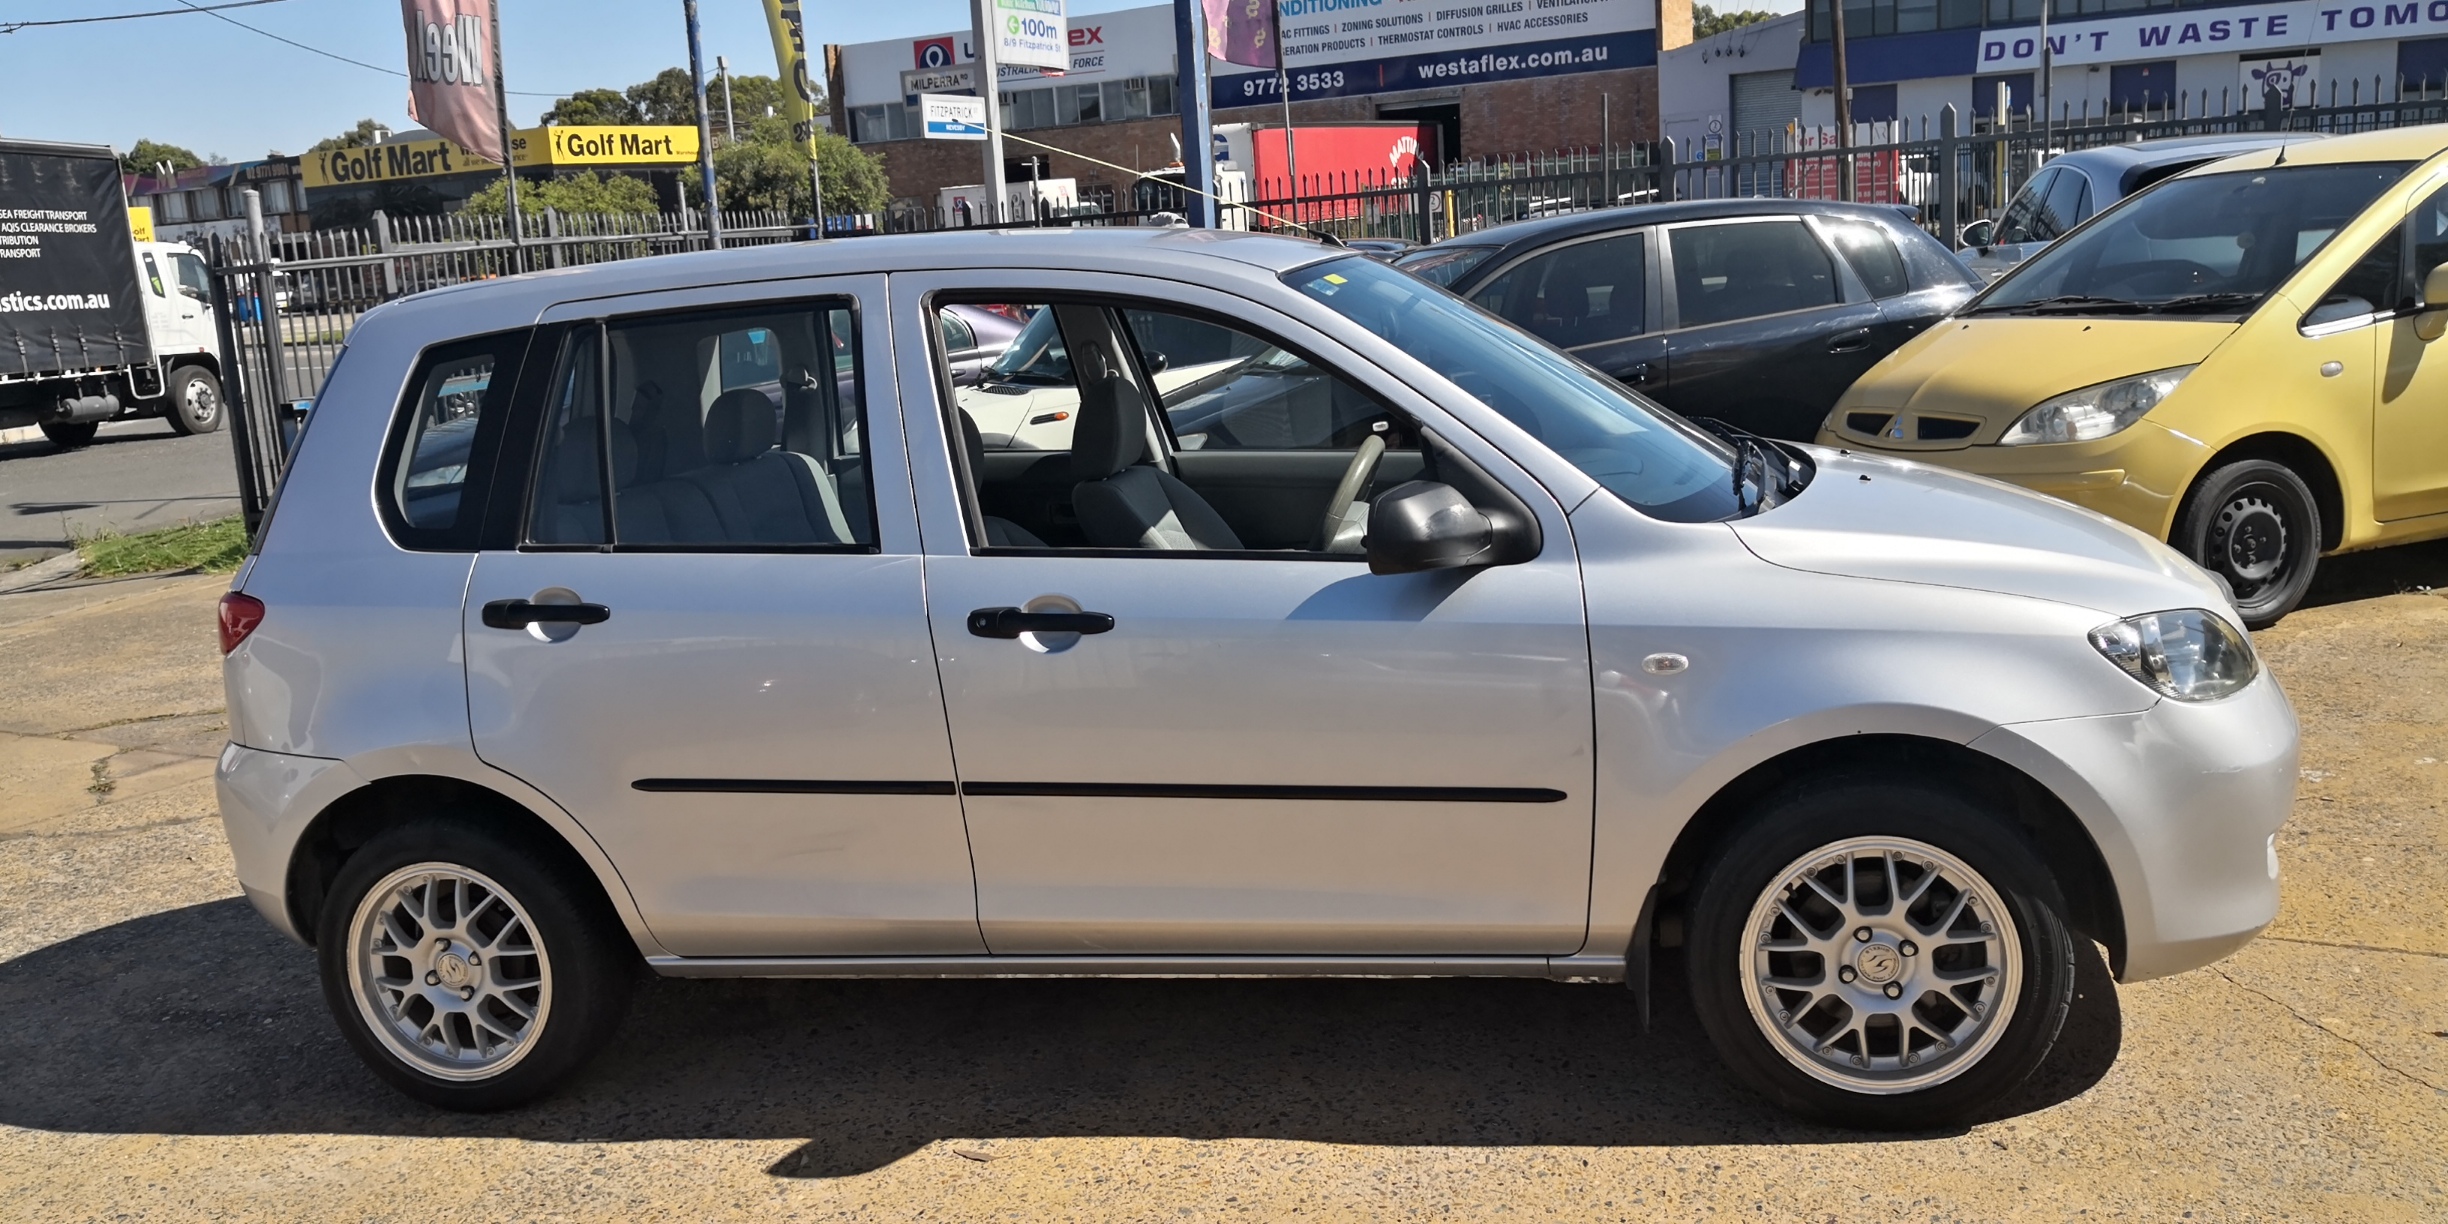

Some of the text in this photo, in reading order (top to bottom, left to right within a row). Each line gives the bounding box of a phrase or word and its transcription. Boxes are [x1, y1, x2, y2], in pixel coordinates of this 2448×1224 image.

[1021, 18, 1057, 39] 100m
[1293, 25, 1330, 38] FITTINGS
[1341, 19, 1374, 32] ZONING
[1375, 13, 1423, 28] SOLUTIONS
[1436, 5, 1483, 20] DIFFUSION
[1486, 2, 1523, 15] GRILLES
[1321, 37, 1365, 52] PRODUCTS
[1377, 30, 1434, 46] THERMOSTAT
[1437, 24, 1484, 39] CONTROLS
[1497, 20, 1521, 31] HVAC
[1523, 12, 1588, 29] ACCESSORIES
[2139, 14, 2288, 47] WASTE
[1019, 39, 1053, 52] Fitzpatrick
[1073, 56, 1104, 68] FORCE
[1296, 70, 1345, 91] 3533
[1418, 46, 1608, 79] westaflex.com.au
[910, 75, 960, 91] MILPERRA
[930, 105, 973, 119] FITZPATRICK
[567, 133, 614, 157] Golf
[620, 133, 673, 156] Mart
[331, 147, 382, 183] Golf
[386, 141, 452, 177] Mart
[13, 209, 46, 220] FREIGHT
[46, 210, 87, 221] TRANSPORT
[1, 222, 97, 233] AQIS CLEARANCE BROKERS
[0, 248, 41, 258] RANSPORT
